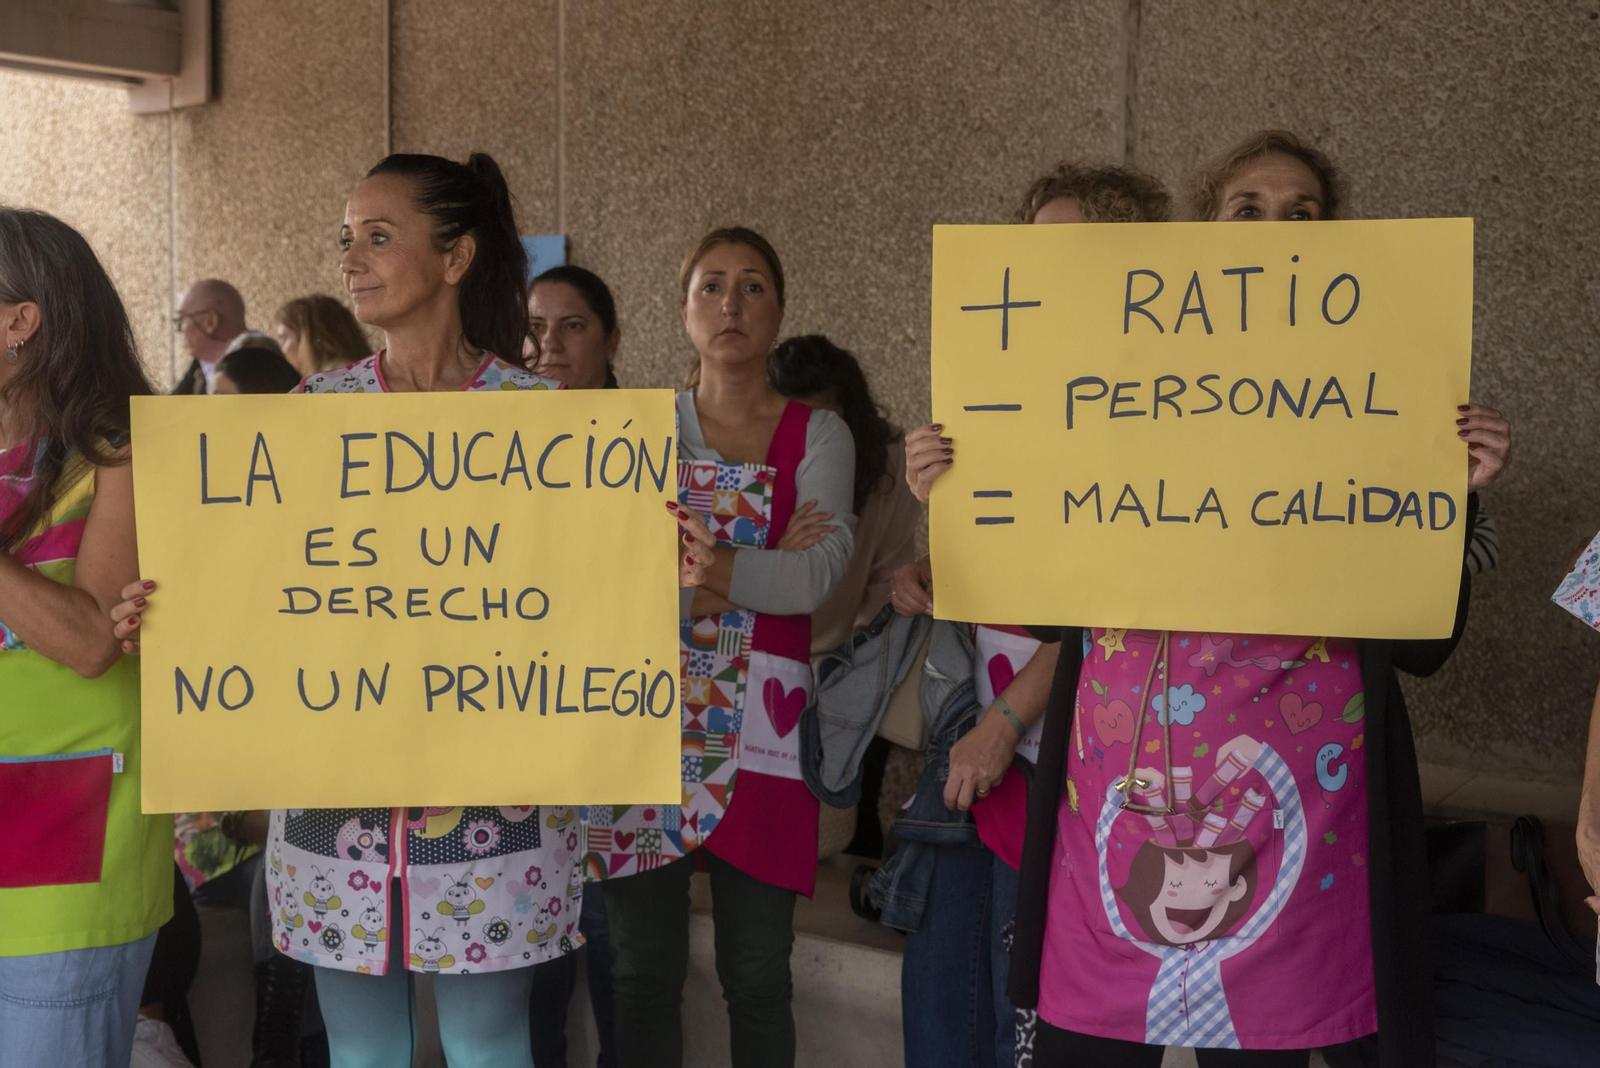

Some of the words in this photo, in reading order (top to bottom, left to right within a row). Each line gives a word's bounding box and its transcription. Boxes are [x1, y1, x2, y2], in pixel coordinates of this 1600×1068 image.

[1067, 372, 1398, 429] PERSONAL
[200, 432, 282, 506] LA
[1064, 479, 1228, 529] MALA
[305, 527, 377, 566] ES
[421, 523, 500, 566] UN
[278, 586, 549, 621] DERECHO
[175, 665, 254, 714] NO
[298, 662, 390, 711] UN
